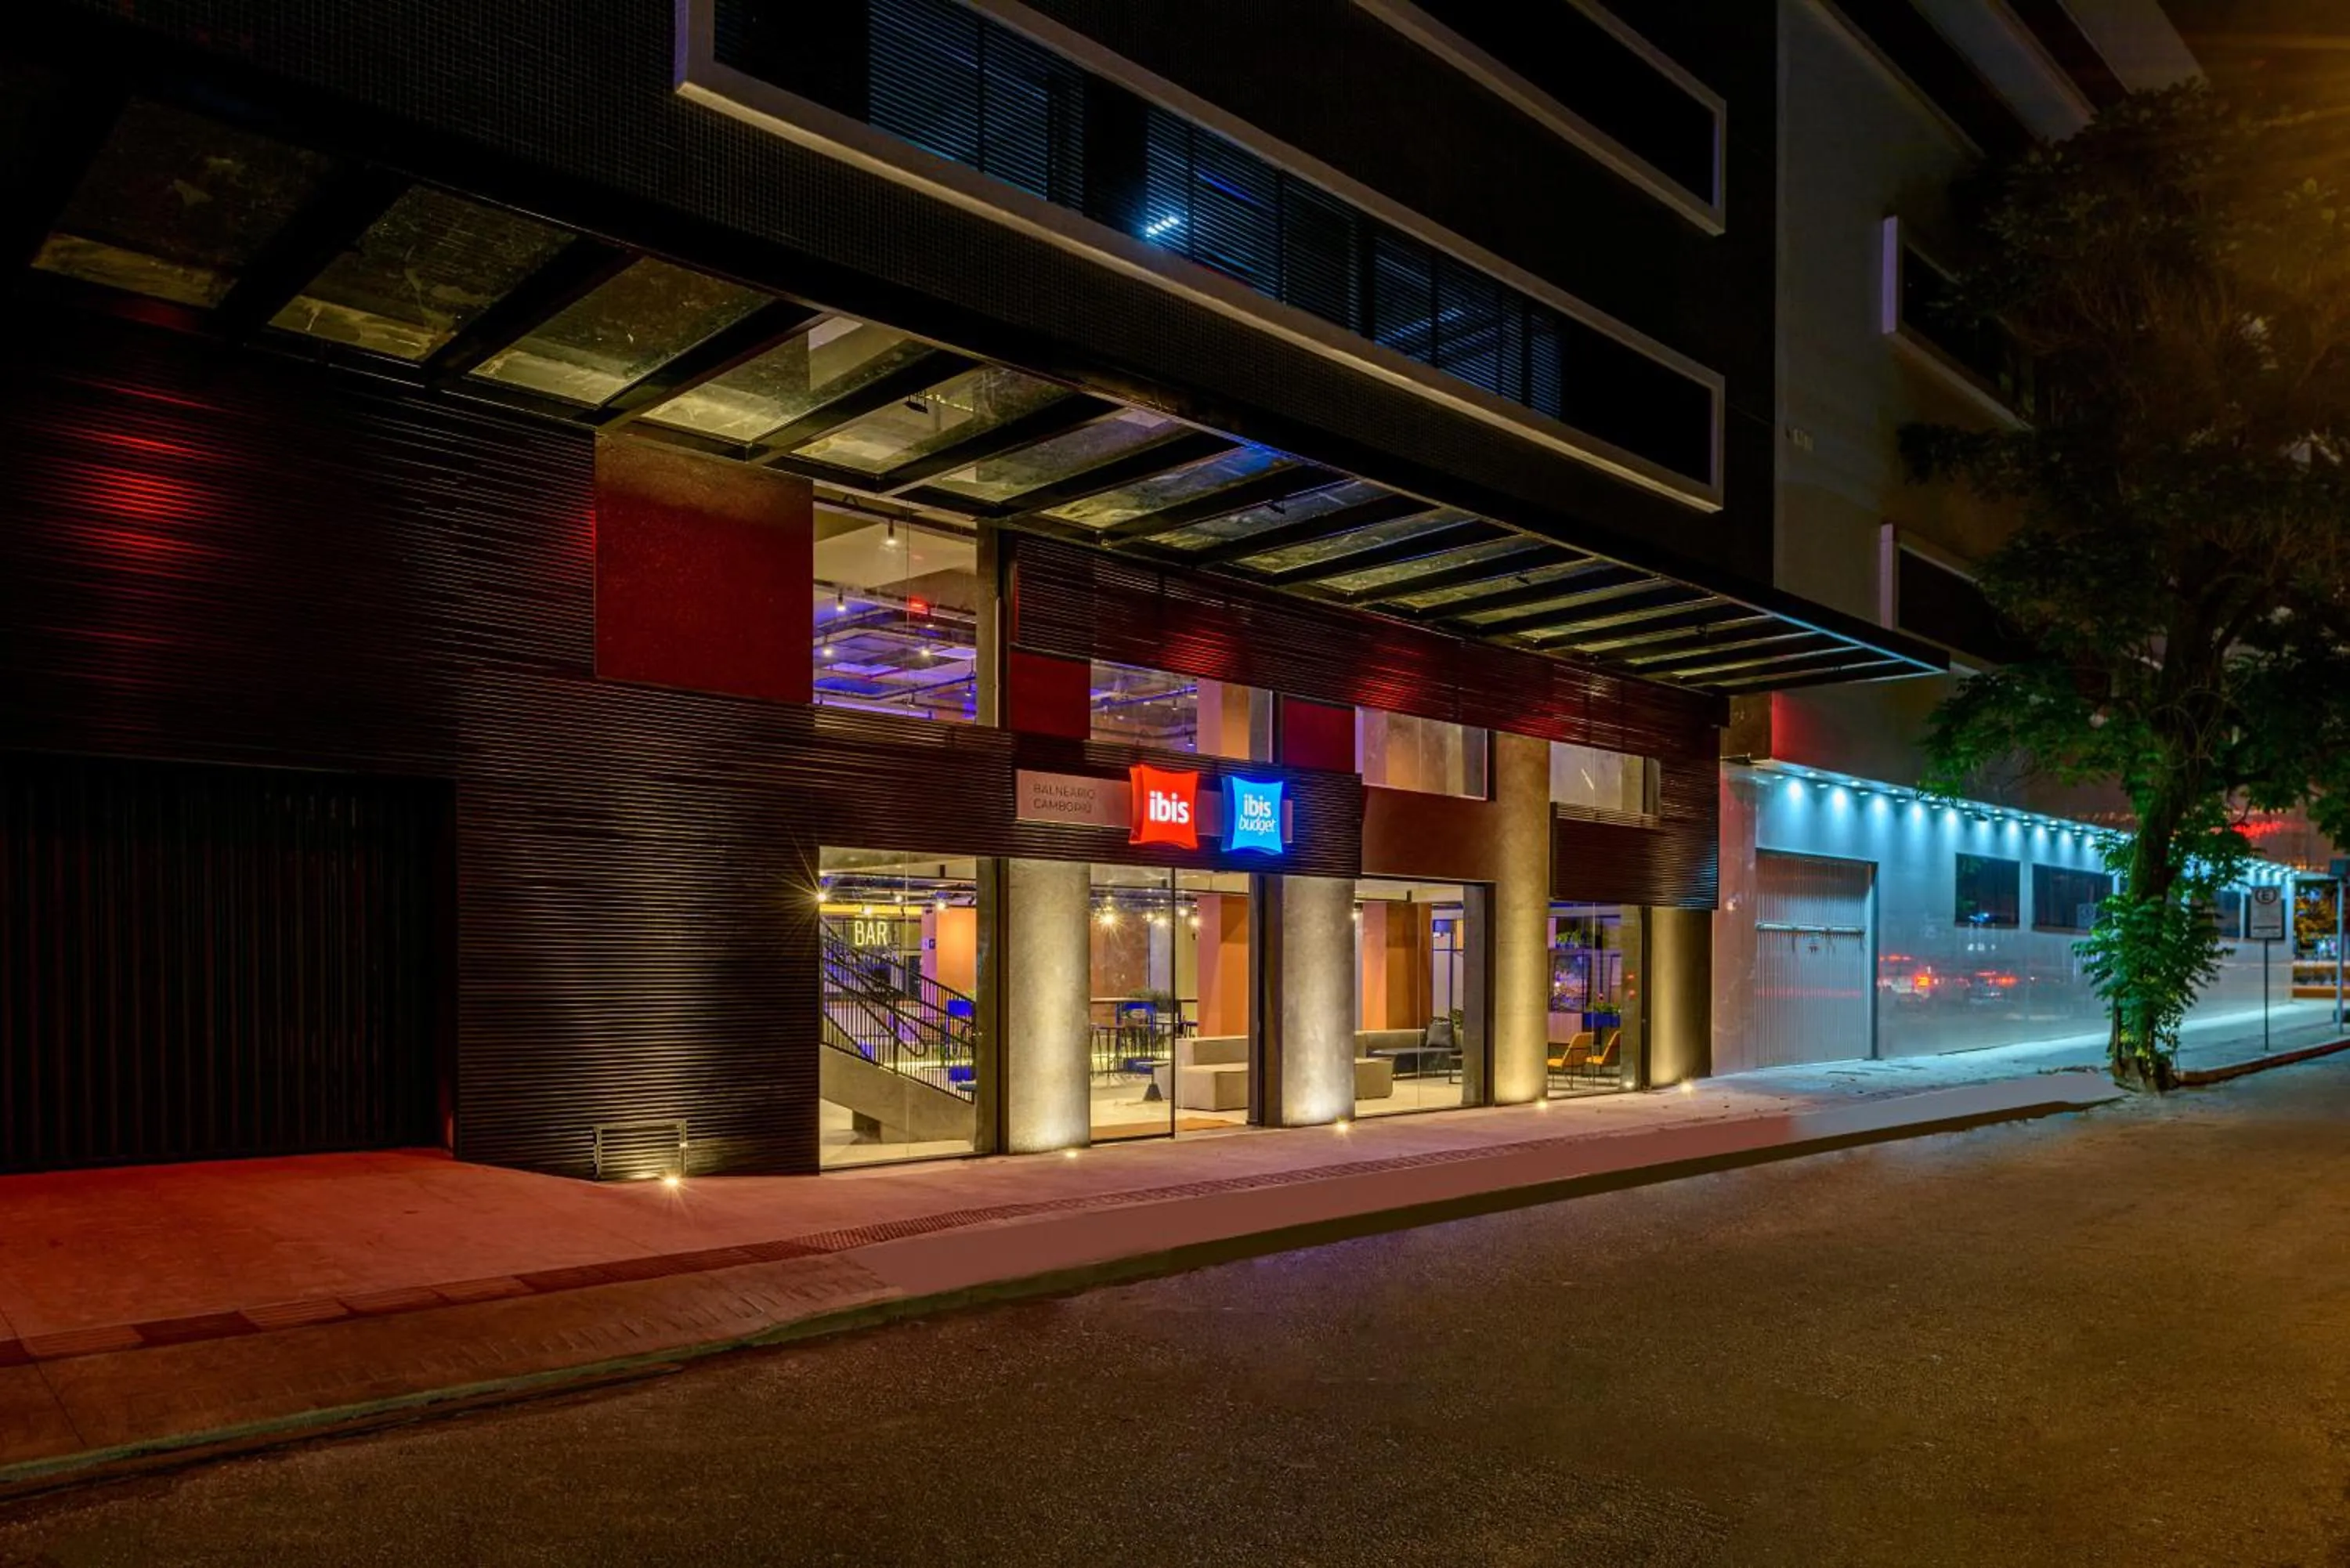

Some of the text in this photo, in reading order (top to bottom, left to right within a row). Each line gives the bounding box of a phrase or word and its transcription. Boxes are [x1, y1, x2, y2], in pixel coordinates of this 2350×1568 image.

[1149, 790, 1190, 824] ibis
[1243, 793, 1272, 818] ibis
[1238, 815, 1276, 836] budget
[855, 920, 888, 946] BAR
